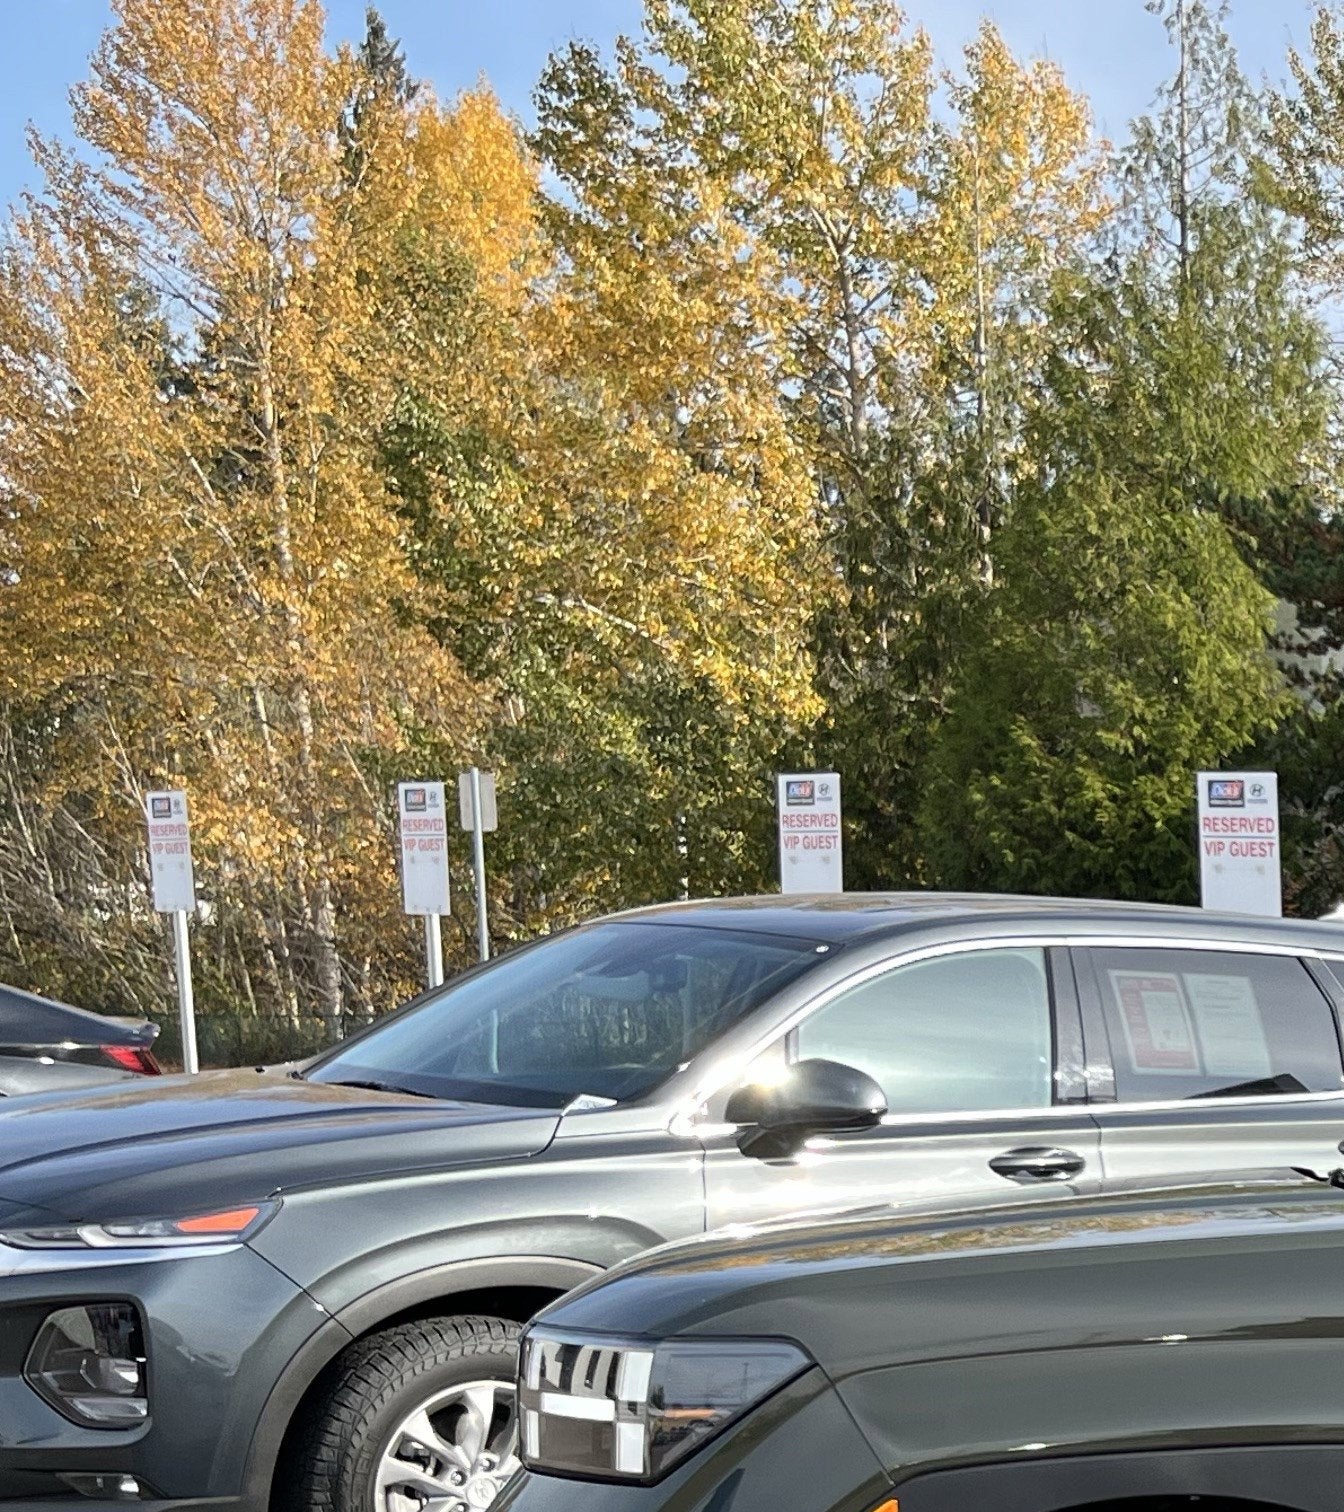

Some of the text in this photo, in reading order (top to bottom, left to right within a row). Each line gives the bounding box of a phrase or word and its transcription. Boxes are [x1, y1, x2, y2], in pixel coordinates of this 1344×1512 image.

[403, 819, 444, 831] RESERVED
[782, 813, 838, 828] RESERVED
[1202, 817, 1275, 833] RESERVED
[151, 824, 188, 836] RESERVED
[152, 842, 188, 854] VIP GUEST
[404, 838, 445, 851] VIP GUEST
[783, 835, 838, 850] VIP GUEST
[1204, 841, 1276, 858] VIP GUEST
